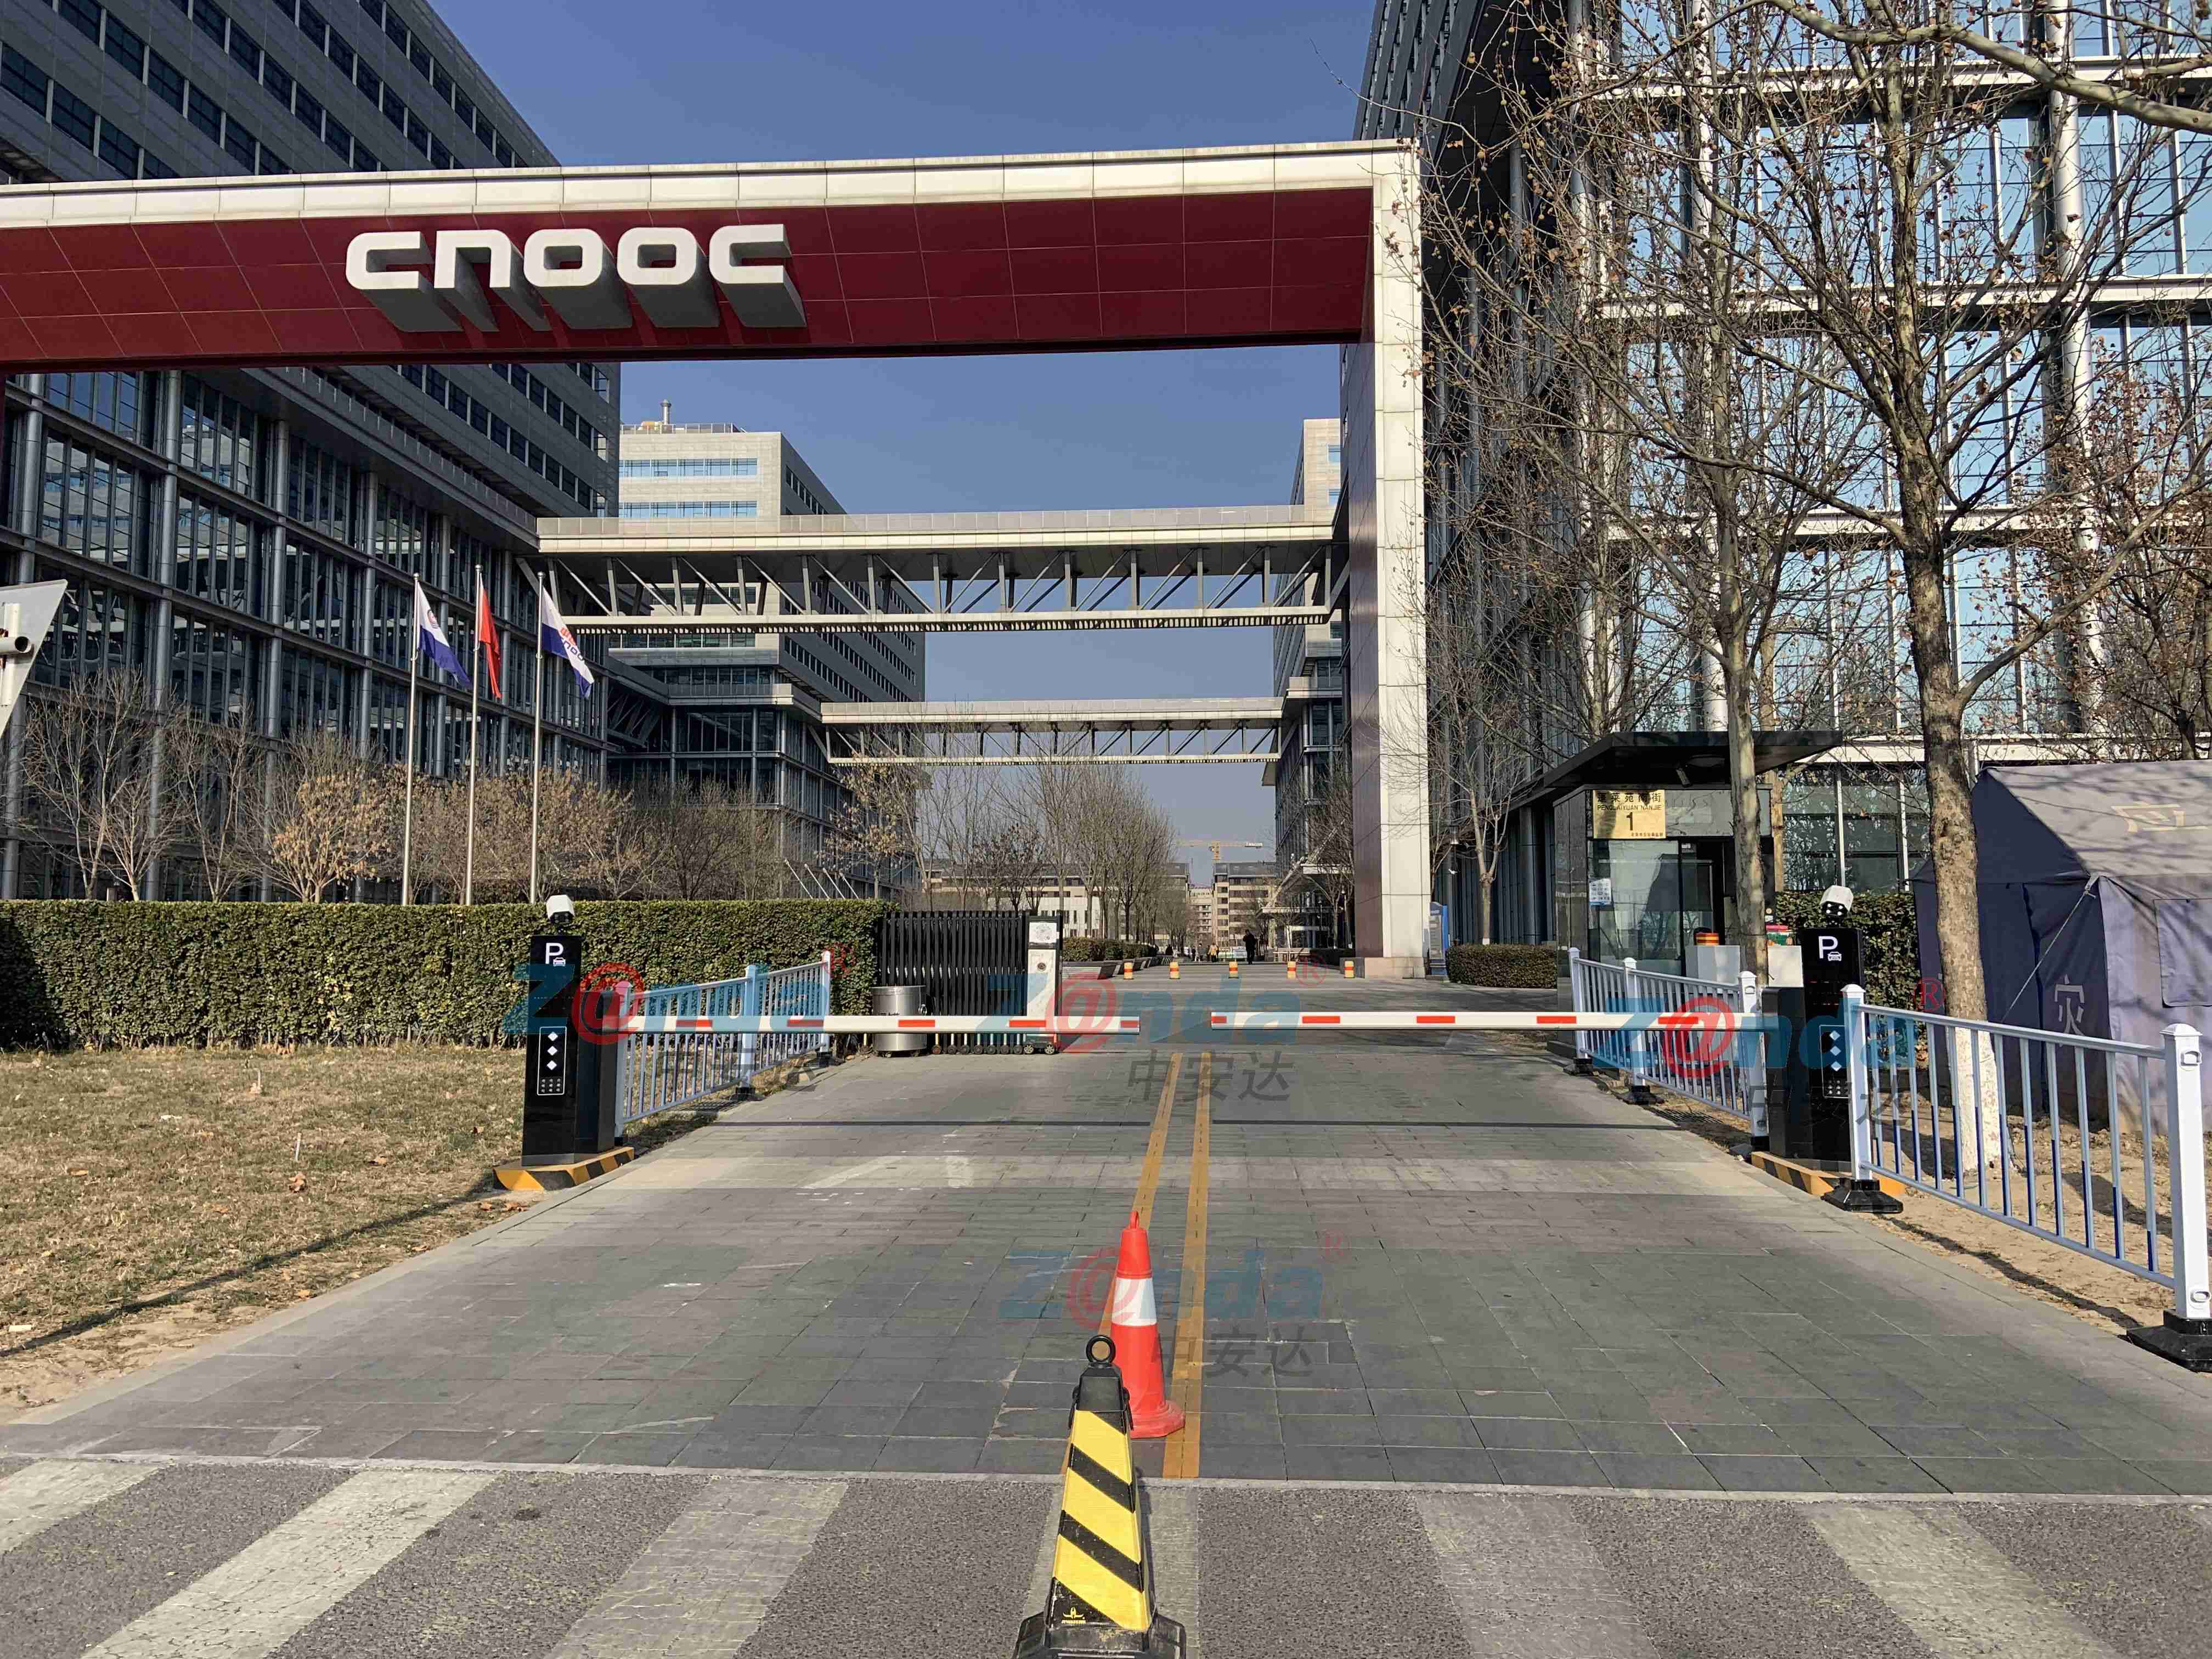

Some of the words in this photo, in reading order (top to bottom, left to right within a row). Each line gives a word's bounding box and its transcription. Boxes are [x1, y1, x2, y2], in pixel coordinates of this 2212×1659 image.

[1626, 811, 1633, 831] 1
[545, 942, 564, 964] P
[1818, 936, 1839, 959] P
